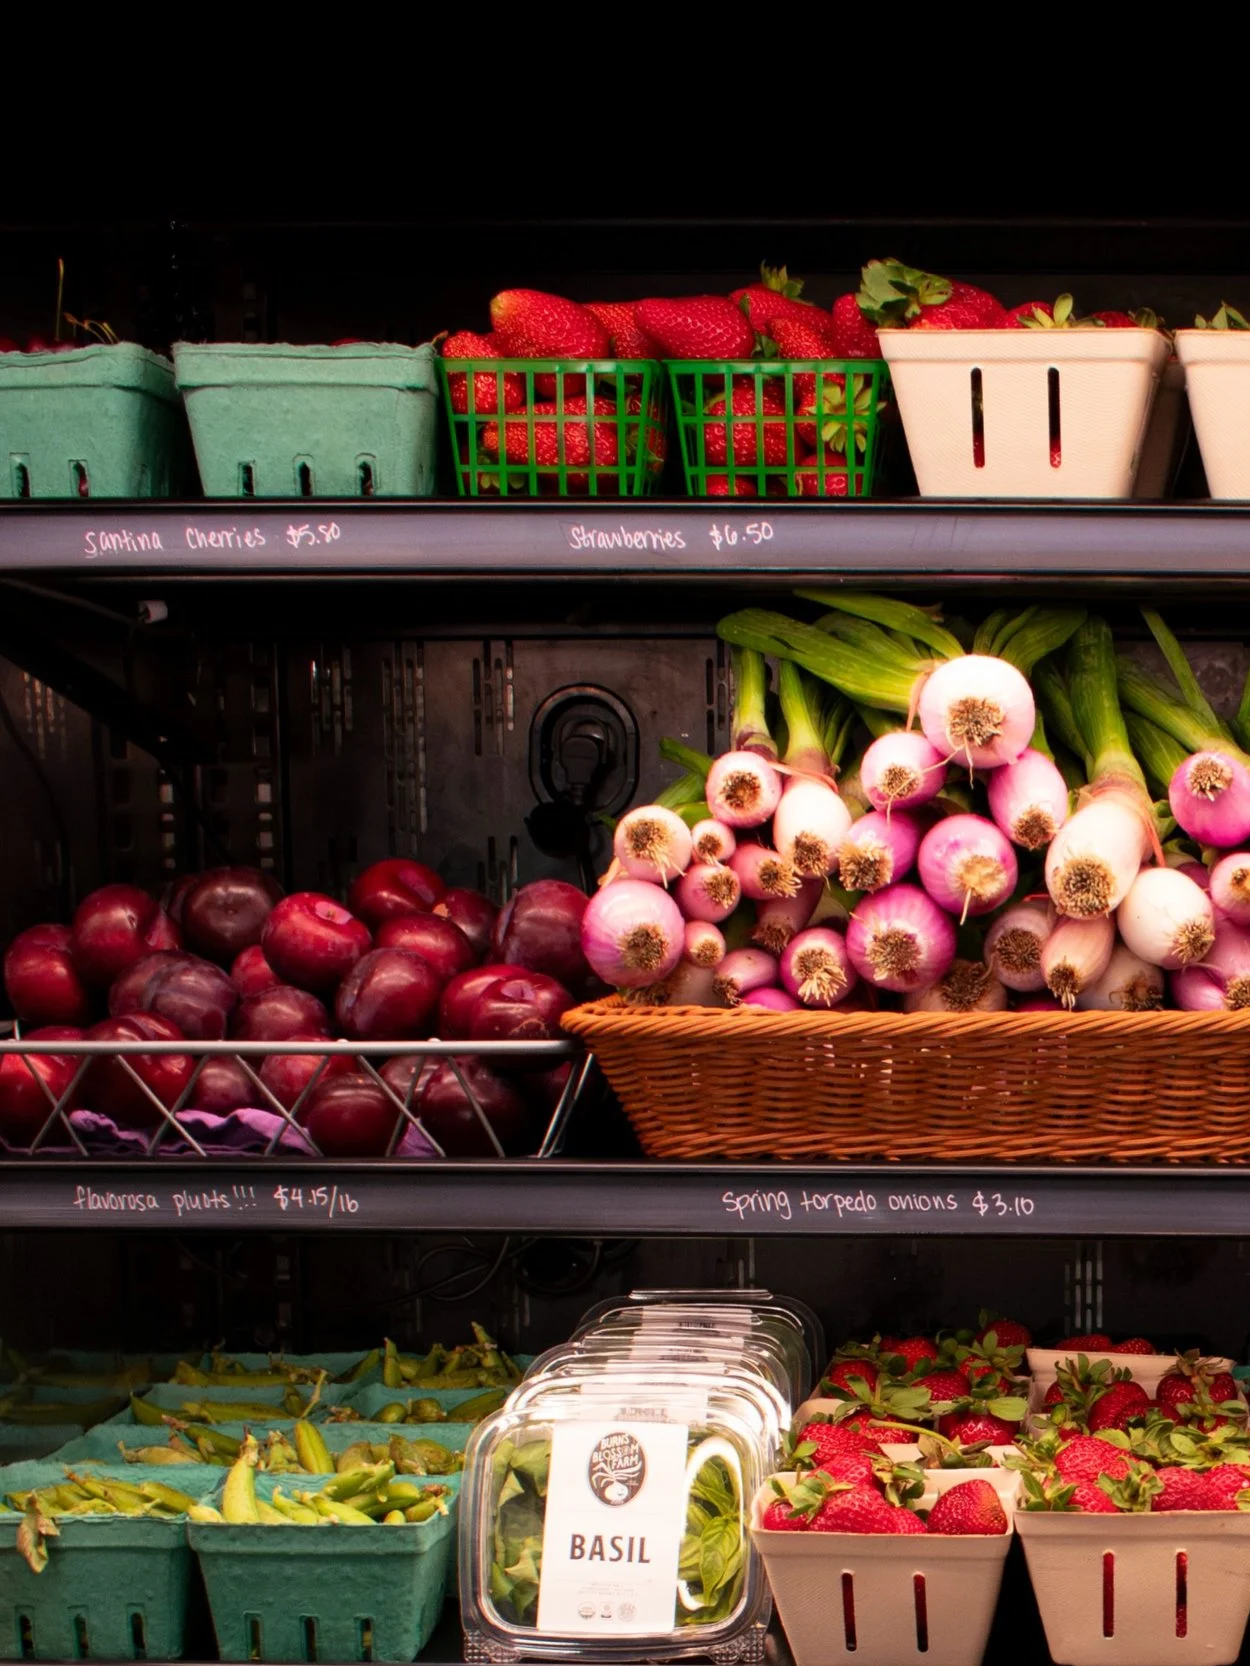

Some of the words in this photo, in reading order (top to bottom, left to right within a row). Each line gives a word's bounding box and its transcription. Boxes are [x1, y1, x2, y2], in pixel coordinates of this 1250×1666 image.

[285, 521, 341, 549] $5.80
[569, 525, 687, 551] Strawberries
[709, 521, 774, 551] $6.50
[800, 1190, 878, 1219] torpedo
[888, 1192, 959, 1212] onions
[971, 1190, 1036, 1217] $3.10
[591, 1442, 641, 1464] BLOSSOM
[600, 1433, 630, 1450] BURNS
[611, 1454, 640, 1470] FARM
[569, 1533, 651, 1564] BASIL
